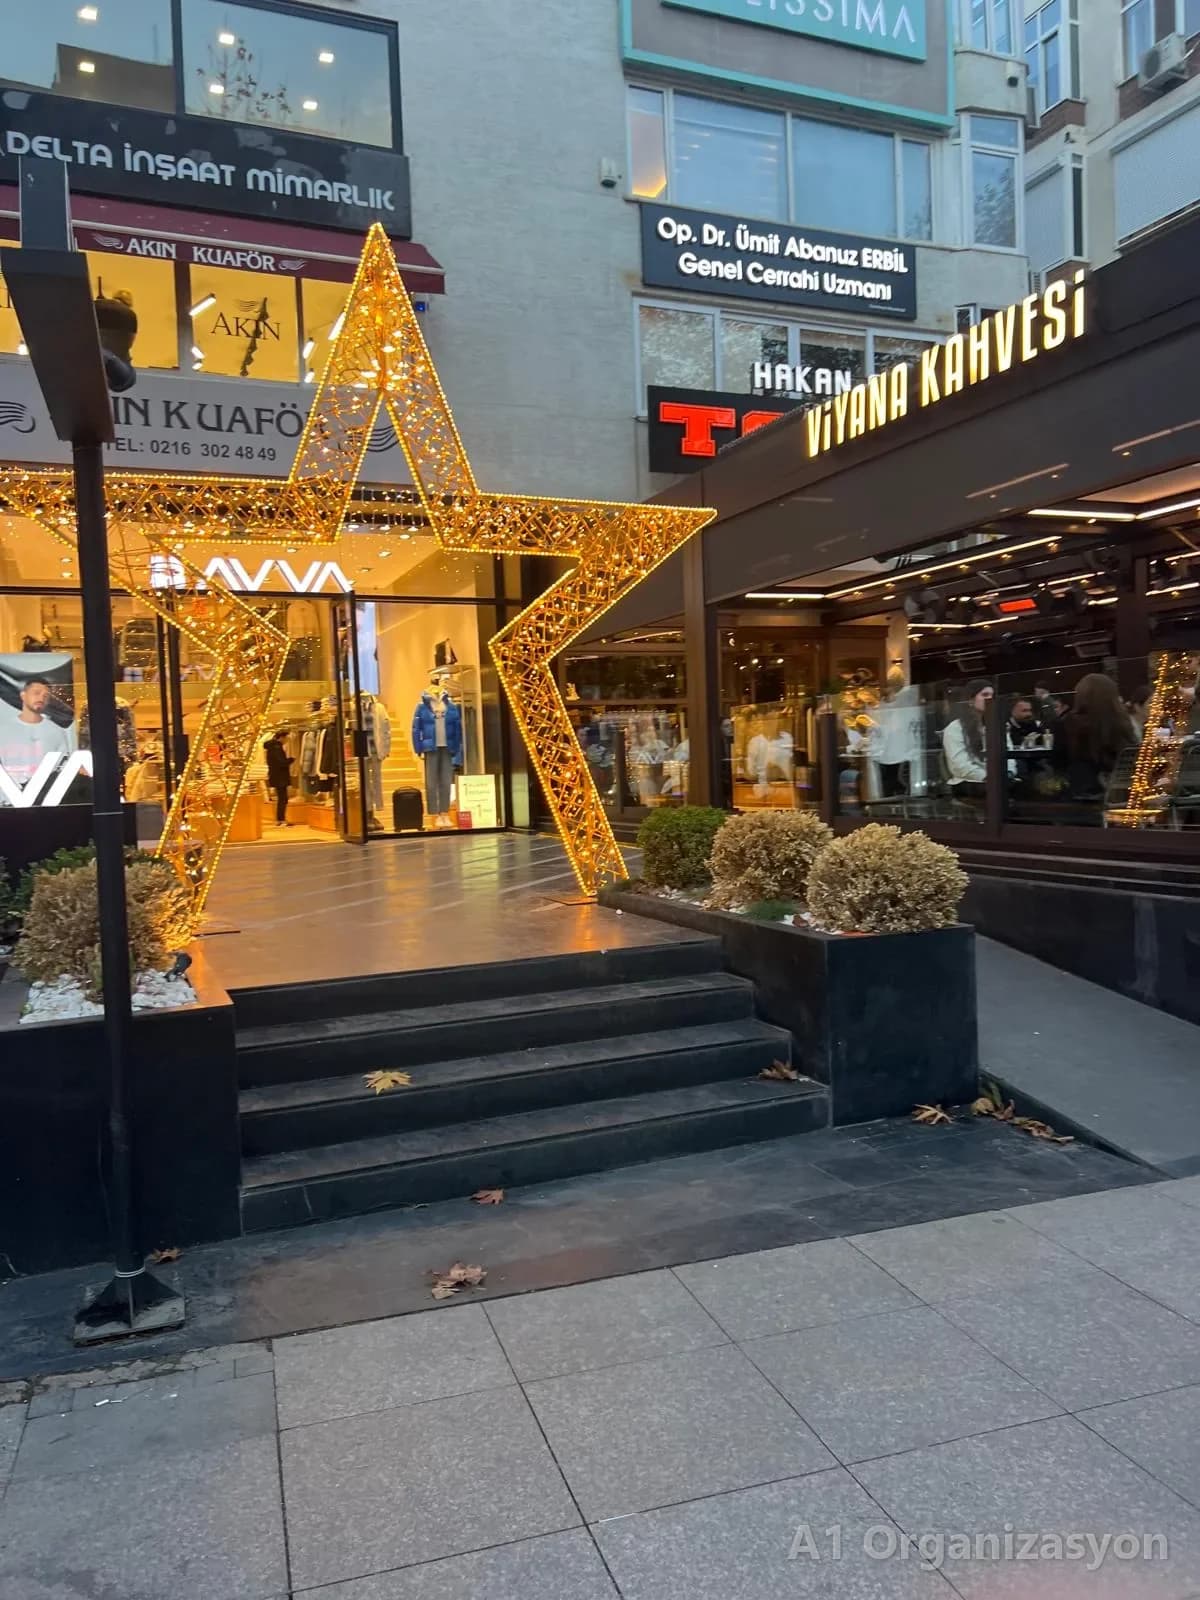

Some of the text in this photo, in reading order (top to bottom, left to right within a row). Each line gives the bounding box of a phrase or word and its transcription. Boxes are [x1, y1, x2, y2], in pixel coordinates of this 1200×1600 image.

[6, 130, 113, 168] DELTA
[126, 238, 276, 272] AKIN KUAFÖR
[657, 216, 909, 274] Op. Dr. Ümit Abanuz ERBİL
[678, 252, 893, 301] Genel Cerrahi Uzmanı
[753, 361, 852, 397] HAKAN
[163, 399, 313, 439] KUAFÖ
[150, 440, 191, 456] 0216
[201, 442, 230, 459] 302
[235, 445, 254, 460] 48
[257, 446, 277, 462] 49
